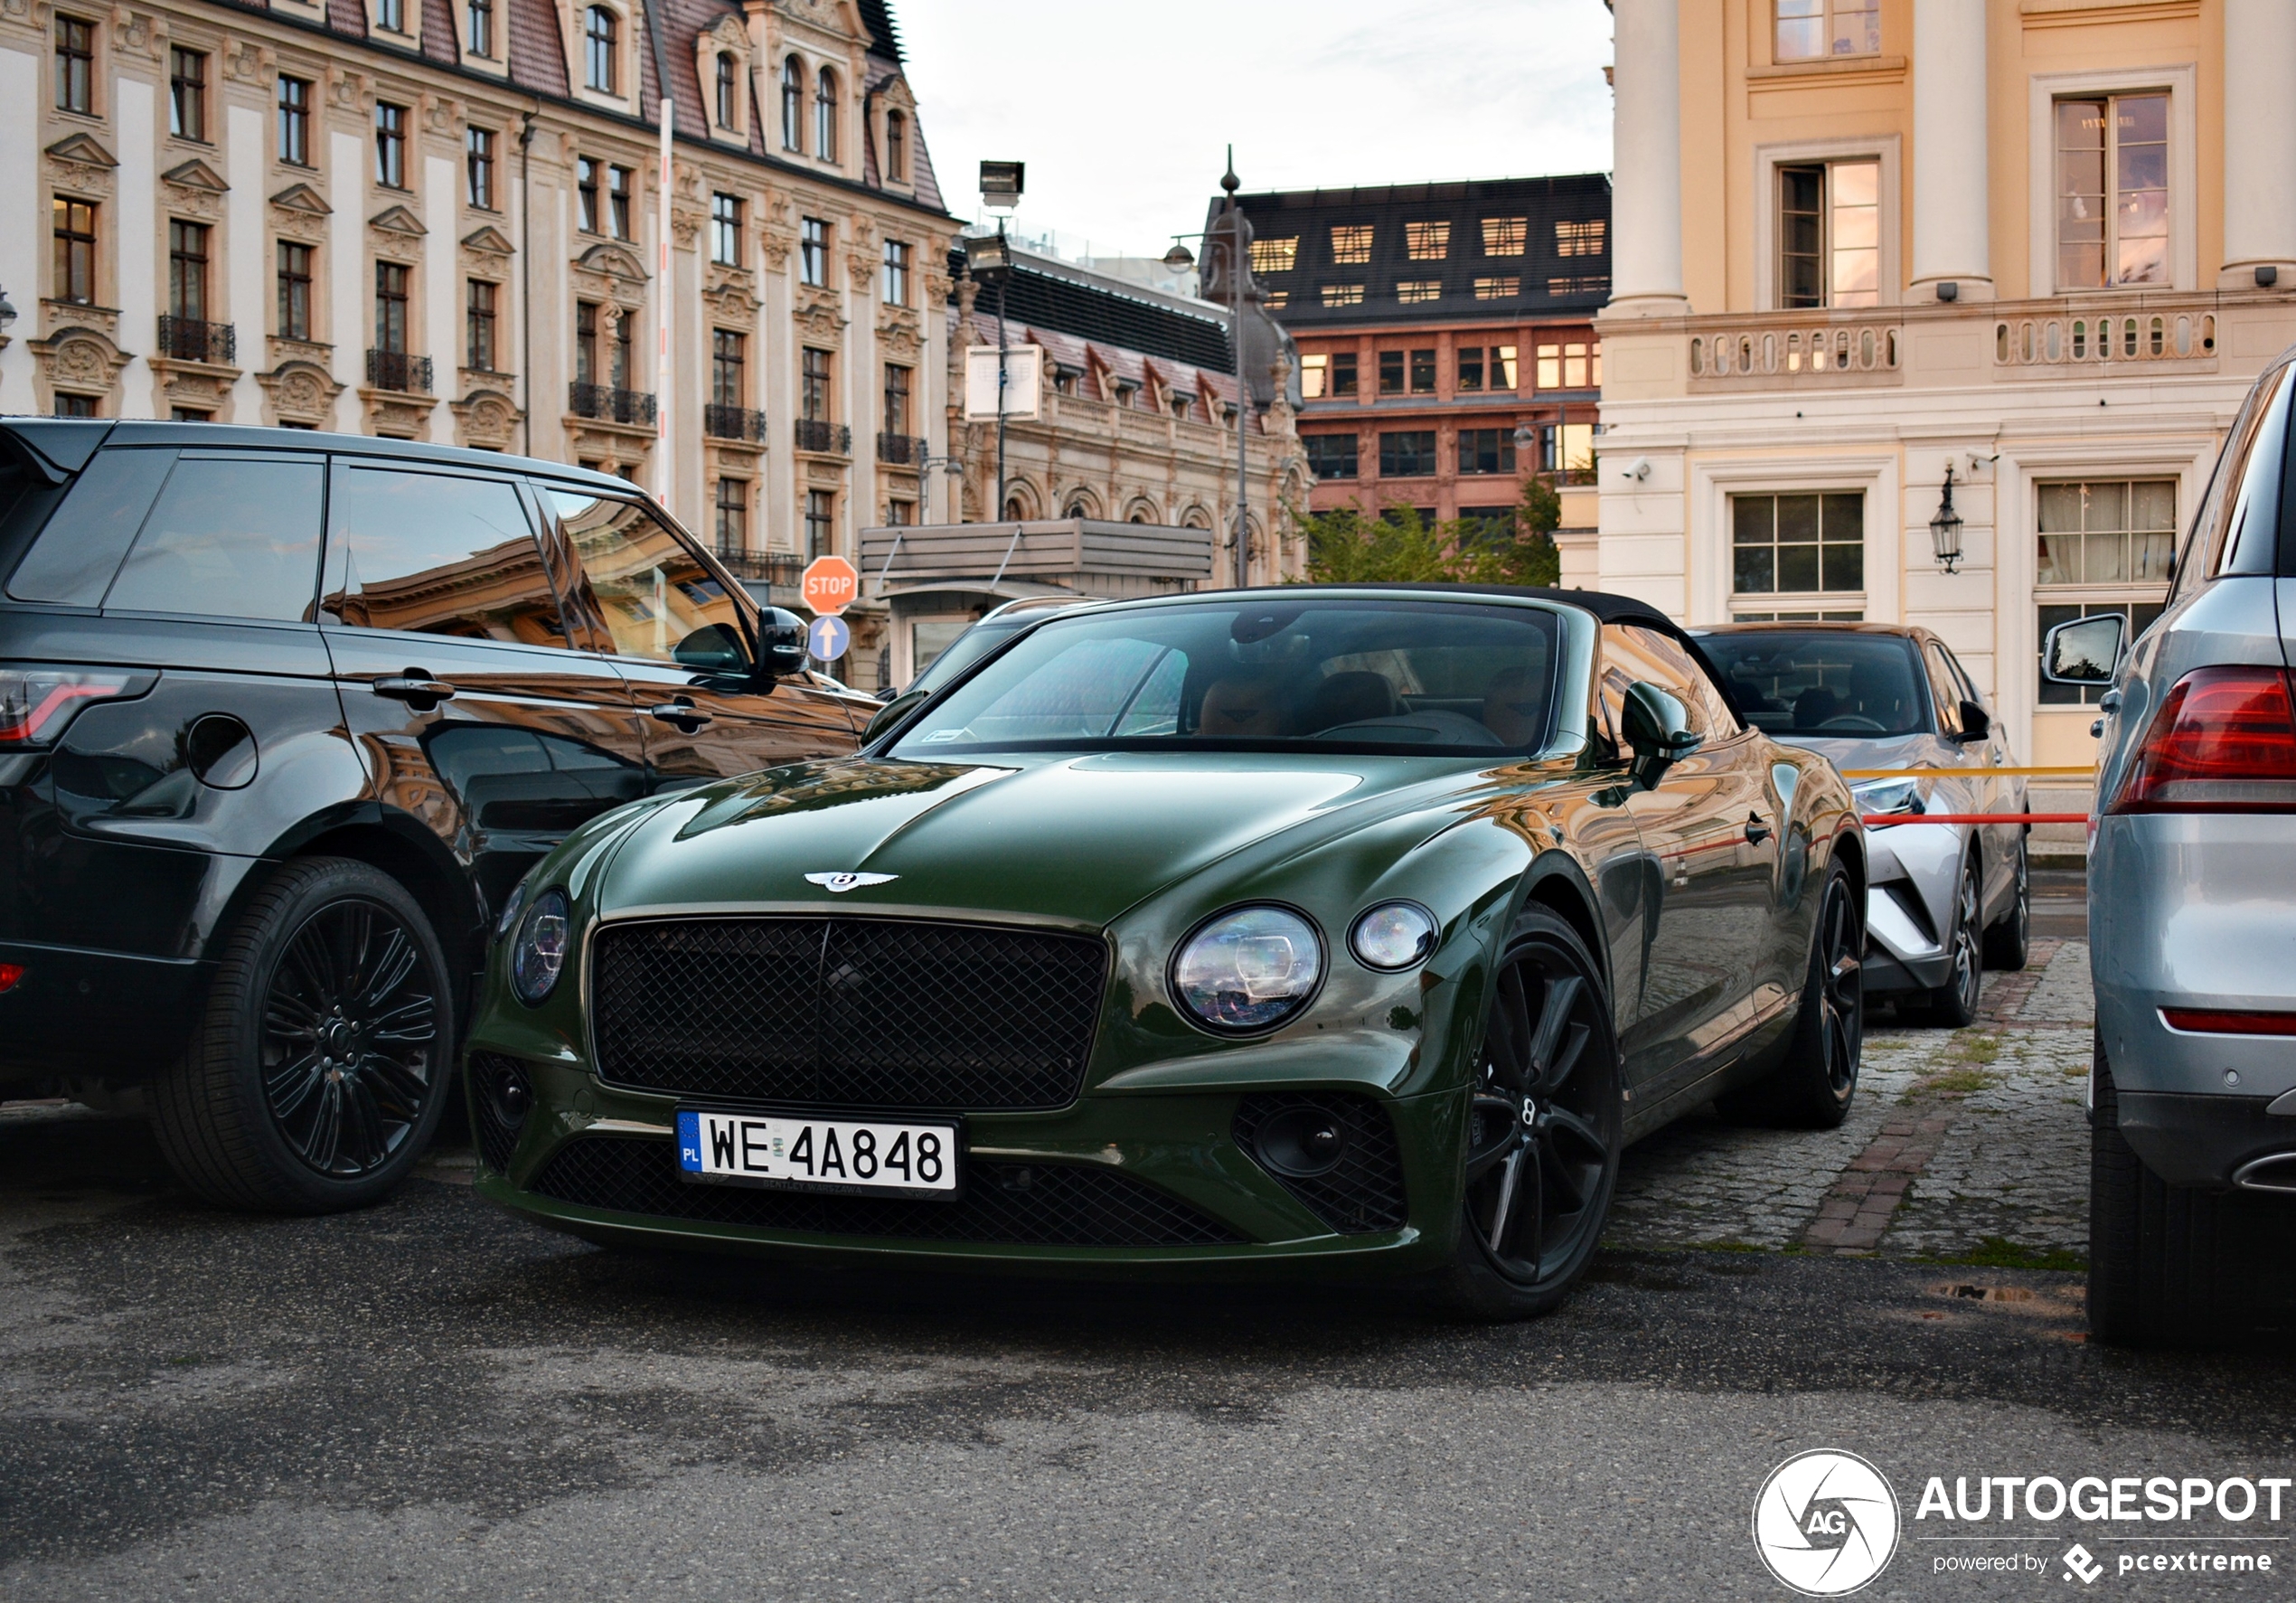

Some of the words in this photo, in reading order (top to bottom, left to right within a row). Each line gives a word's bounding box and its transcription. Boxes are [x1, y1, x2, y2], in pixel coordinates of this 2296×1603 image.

[808, 577, 852, 595] STOP
[682, 1148, 700, 1163] PL
[709, 1118, 769, 1172] WE
[789, 1126, 943, 1183] 4A848
[763, 1179, 806, 1191] BENTLEY
[807, 1183, 863, 1193] WARSZAWA
